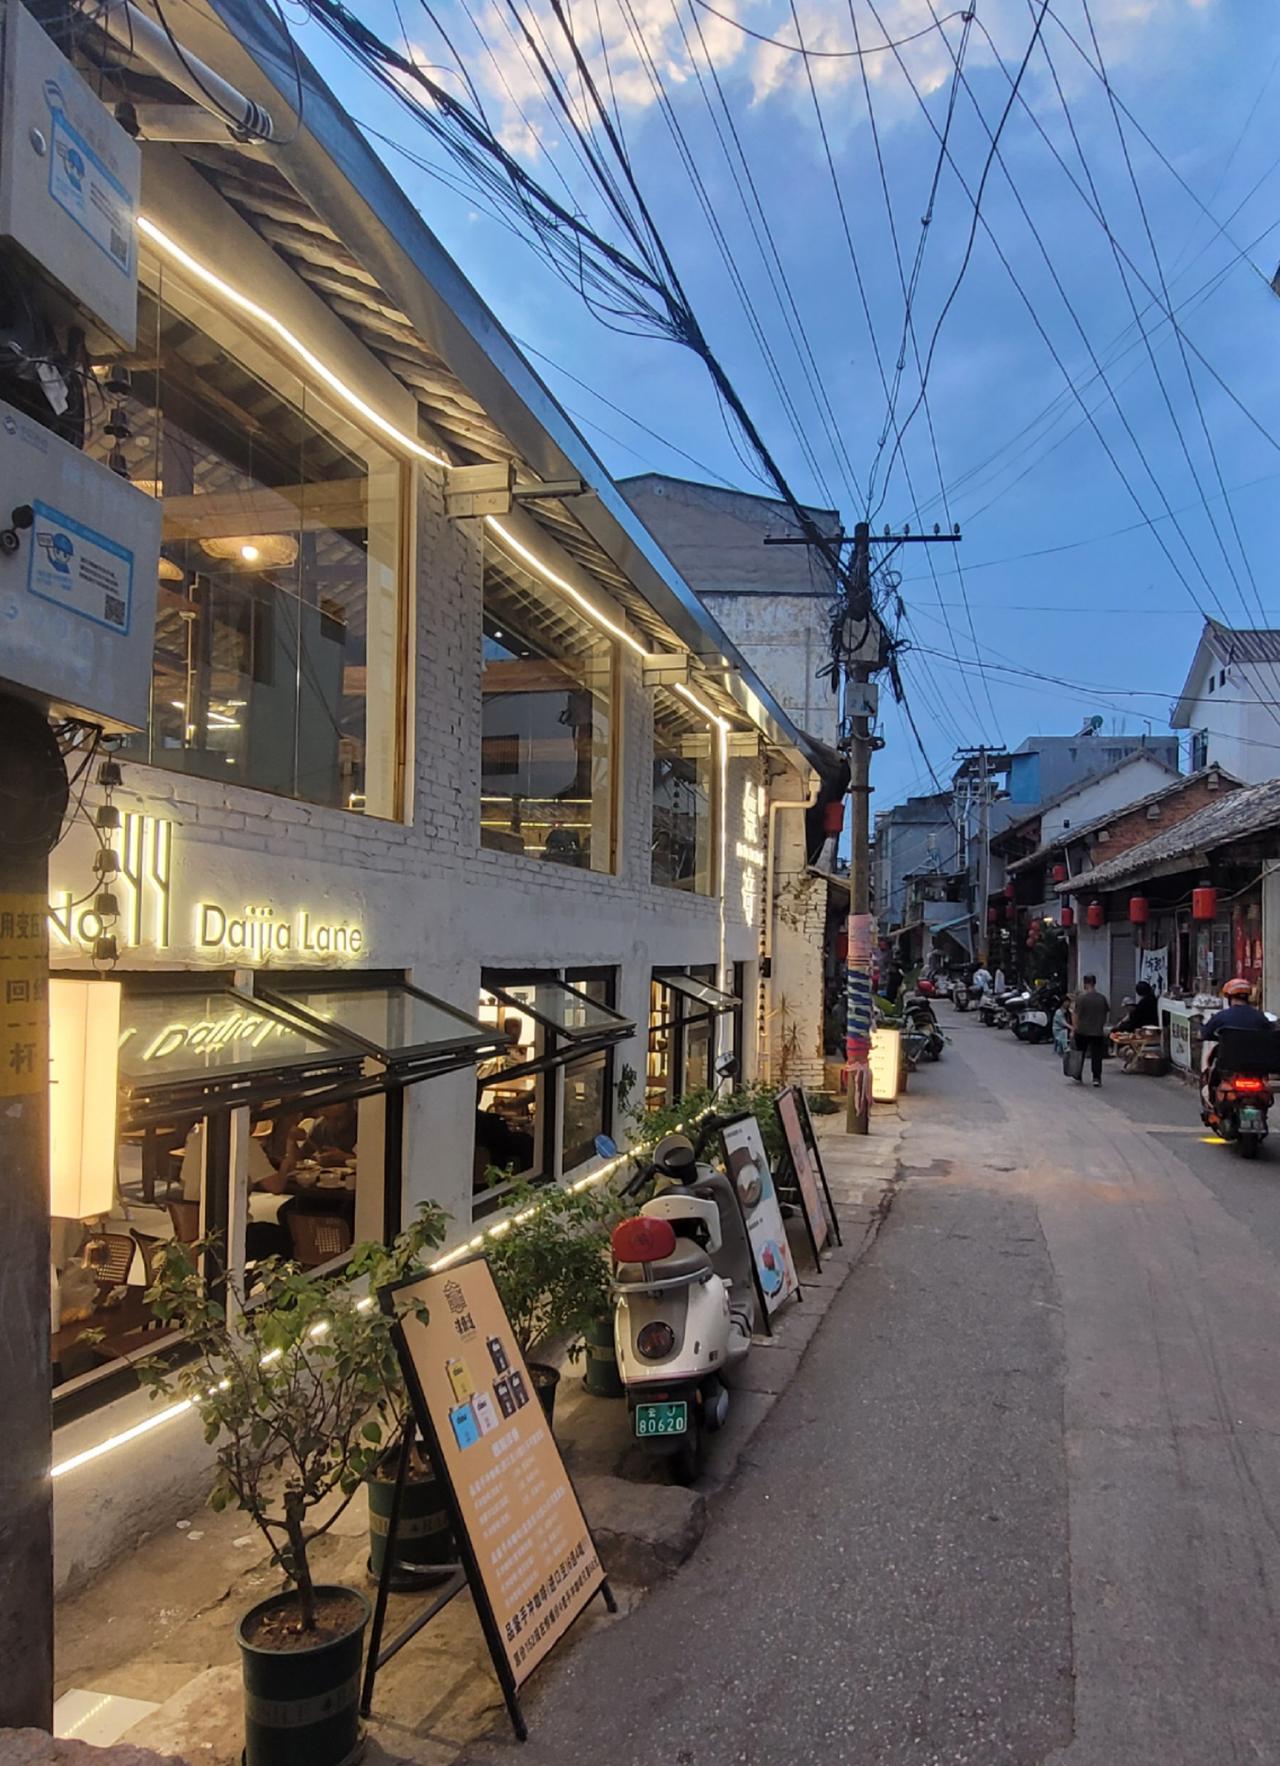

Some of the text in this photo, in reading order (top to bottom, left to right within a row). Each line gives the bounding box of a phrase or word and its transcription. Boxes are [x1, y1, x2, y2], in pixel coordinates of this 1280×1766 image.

[199, 904, 291, 957] Daijia
[299, 911, 363, 954] Lane
[639, 1417, 683, 1433] 80620
